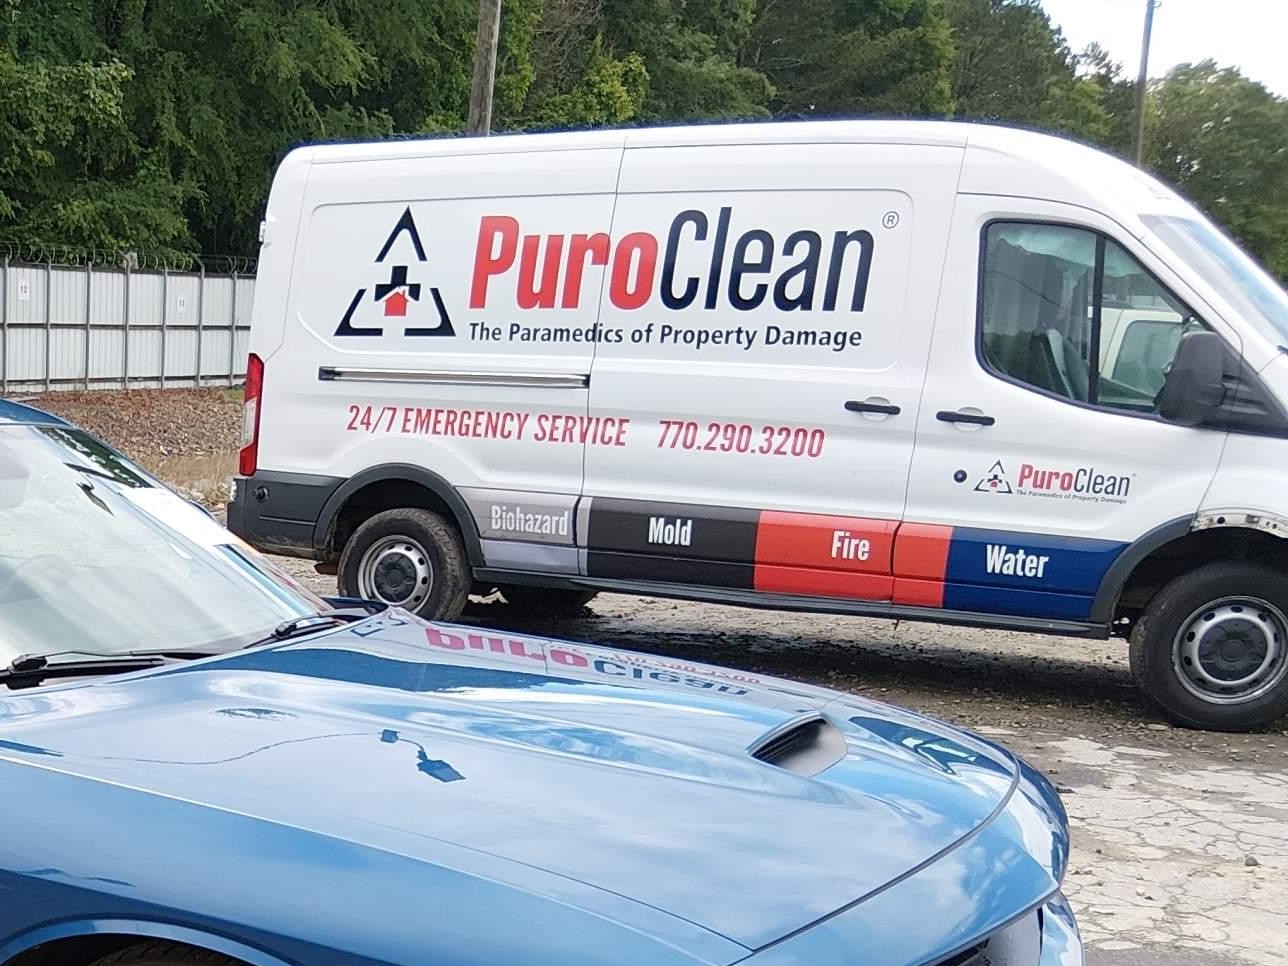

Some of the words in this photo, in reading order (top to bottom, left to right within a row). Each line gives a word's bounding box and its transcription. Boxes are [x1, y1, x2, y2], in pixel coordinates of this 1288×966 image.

[469, 321, 502, 341] The
[509, 323, 623, 344] Paramedics
[631, 323, 654, 344] of
[660, 325, 757, 350] Property
[765, 326, 862, 352] Damage
[346, 405, 397, 434] 24/7
[401, 408, 529, 441] EMERGENCY
[533, 414, 630, 446] SERVICE
[656, 420, 825, 458] 770.290.3200
[491, 505, 569, 536] Biohazard
[648, 517, 692, 546] Mold
[831, 531, 870, 561] Fire
[986, 543, 1049, 578] Water
